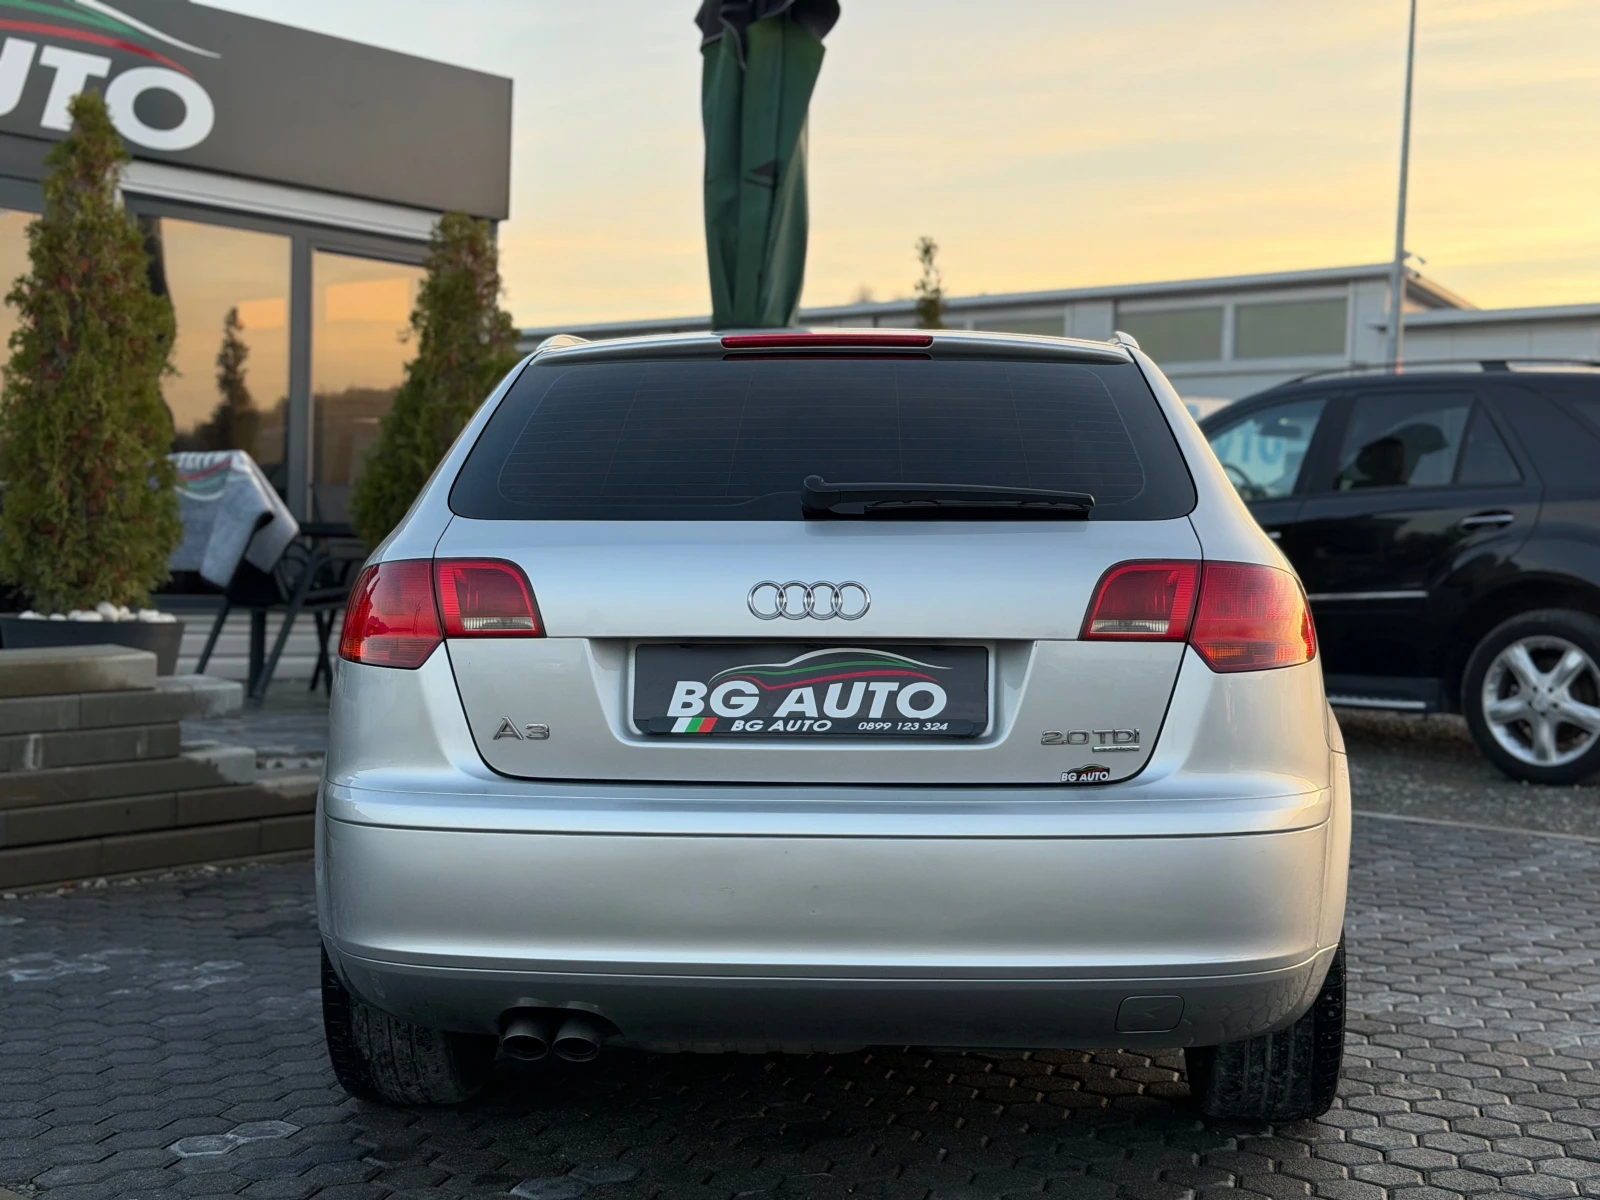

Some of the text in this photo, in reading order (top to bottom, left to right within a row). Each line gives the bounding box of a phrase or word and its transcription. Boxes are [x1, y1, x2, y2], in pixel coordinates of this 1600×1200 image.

[666, 680, 948, 719] BG AUTO
[492, 715, 550, 740] A3
[730, 720, 832, 732] BG AUTO
[857, 722, 949, 731] 0899 123 324
[1041, 728, 1140, 745] 2.0 TDI
[1061, 771, 1109, 781] BG AUTO
